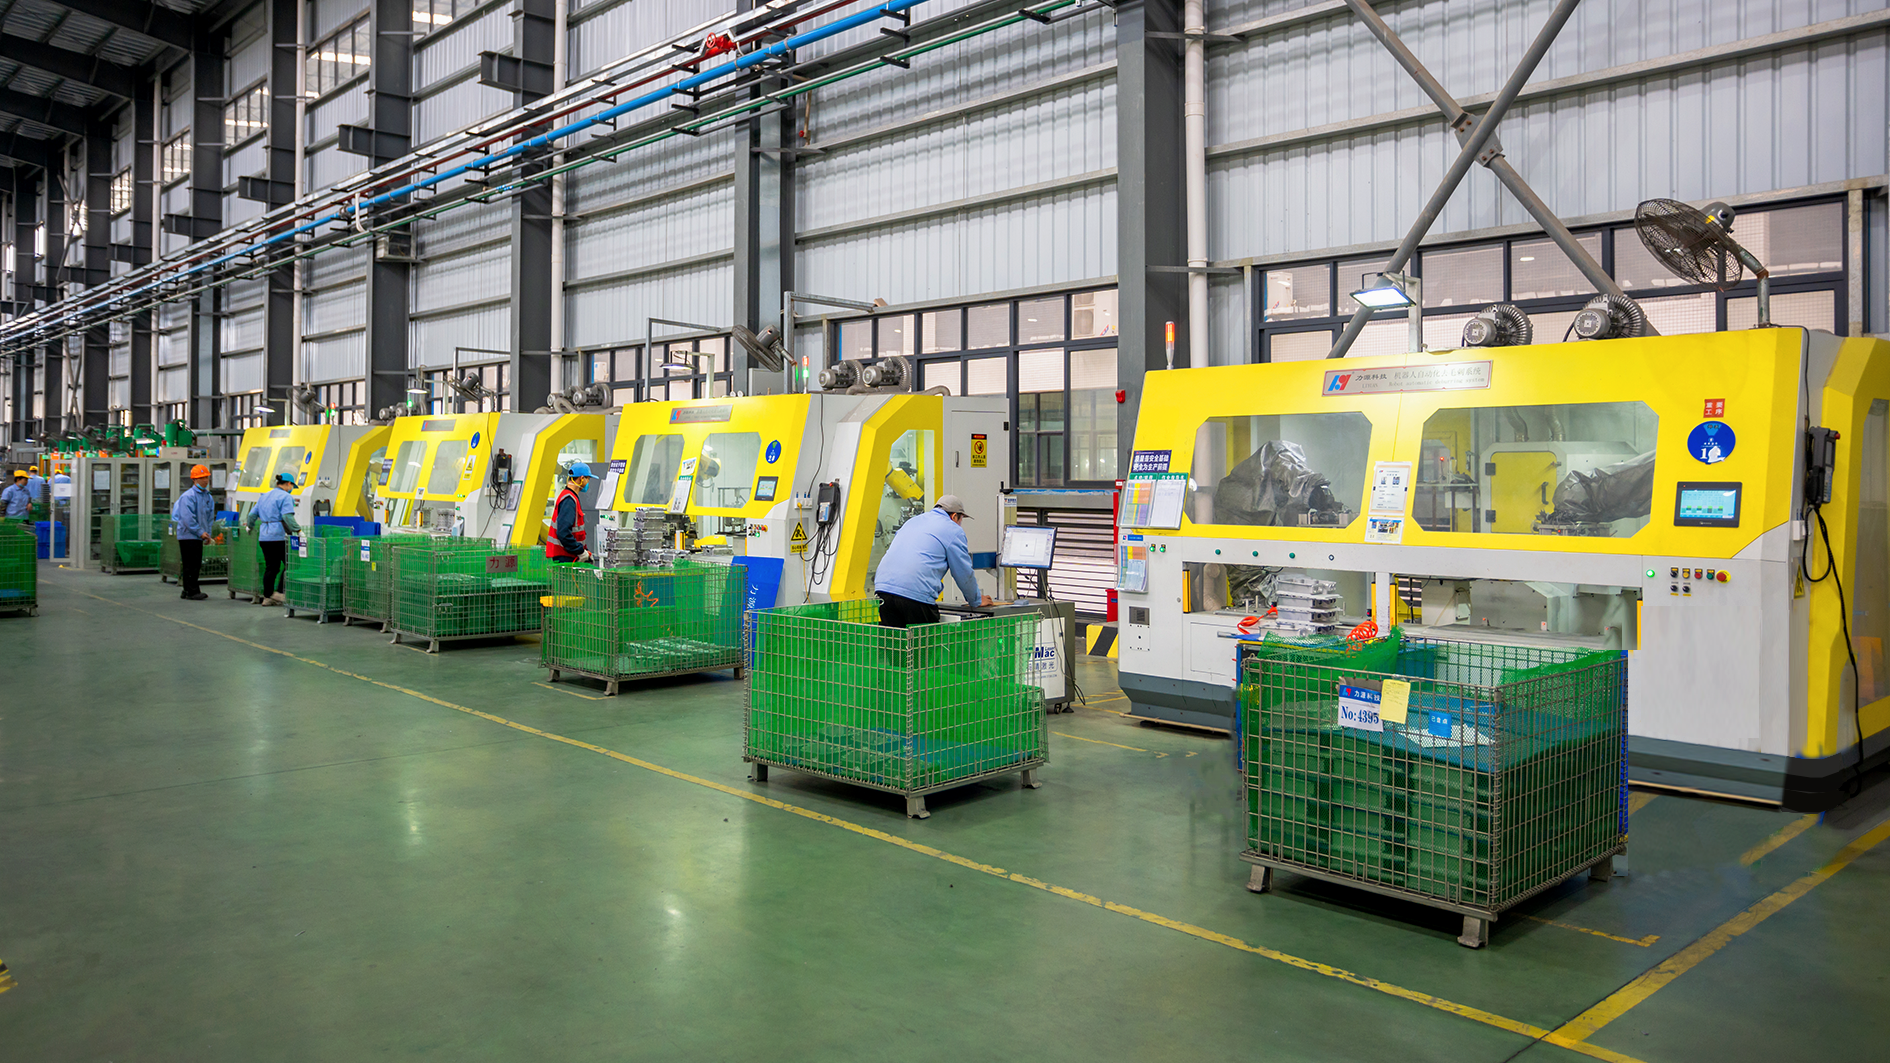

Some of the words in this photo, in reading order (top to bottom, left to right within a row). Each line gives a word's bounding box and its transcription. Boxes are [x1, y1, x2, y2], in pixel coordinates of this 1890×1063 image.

[1355, 373, 1387, 382] 力源科技
[1705, 408, 1722, 416] 工序
[489, 555, 515, 569] 力源
[1354, 690, 1380, 702] 力源科技
[1341, 705, 1379, 724] No:4395
